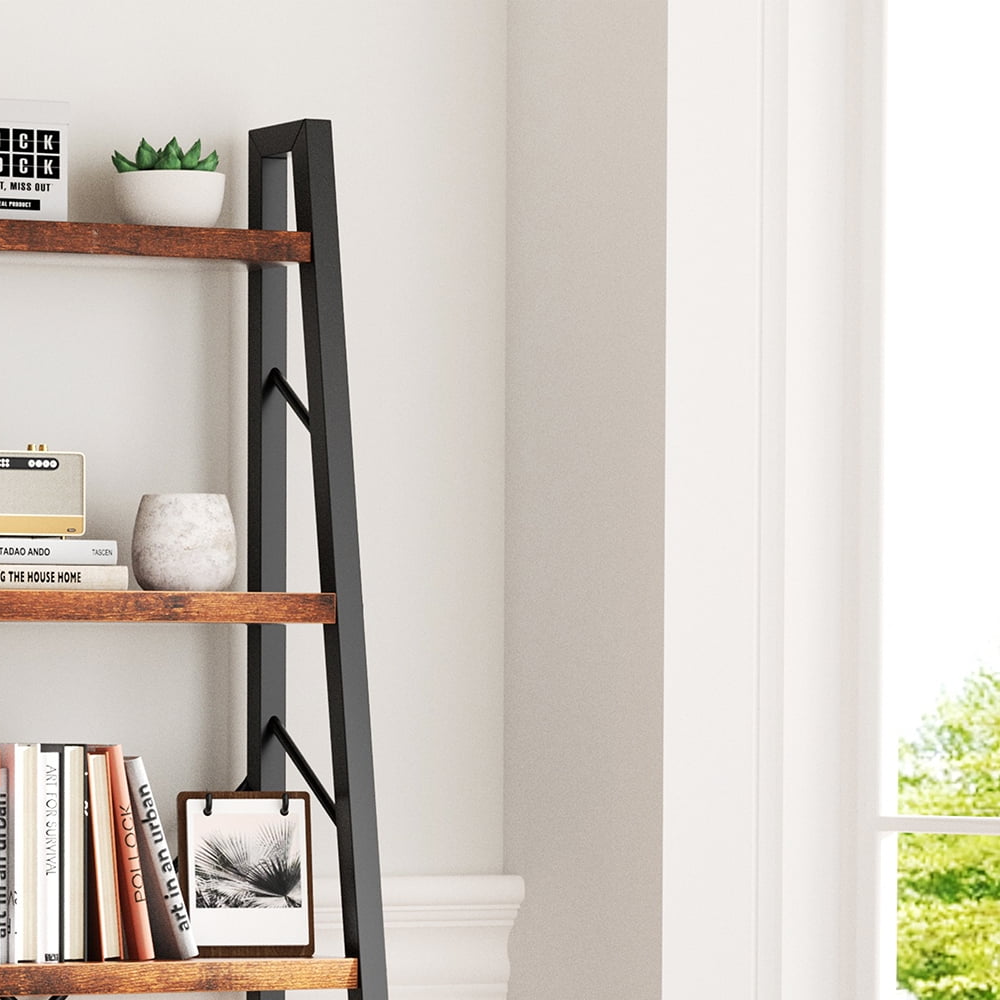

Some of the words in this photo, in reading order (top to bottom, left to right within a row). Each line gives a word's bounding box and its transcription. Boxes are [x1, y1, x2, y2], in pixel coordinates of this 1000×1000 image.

[10, 182, 32, 192] MISS
[34, 183, 51, 192] OUT
[0, 547, 26, 556] TADAO
[27, 547, 50, 556] ANDO
[8, 571, 25, 583] THE
[27, 571, 55, 583] HOUSE
[57, 571, 82, 583] HOME
[45, 764, 57, 787] ART
[45, 793, 57, 817] FOR
[139, 784, 164, 844] urban
[45, 821, 57, 876] SURVIVAL
[157, 848, 173, 874] an
[164, 877, 180, 901] in
[171, 902, 190, 932] art
